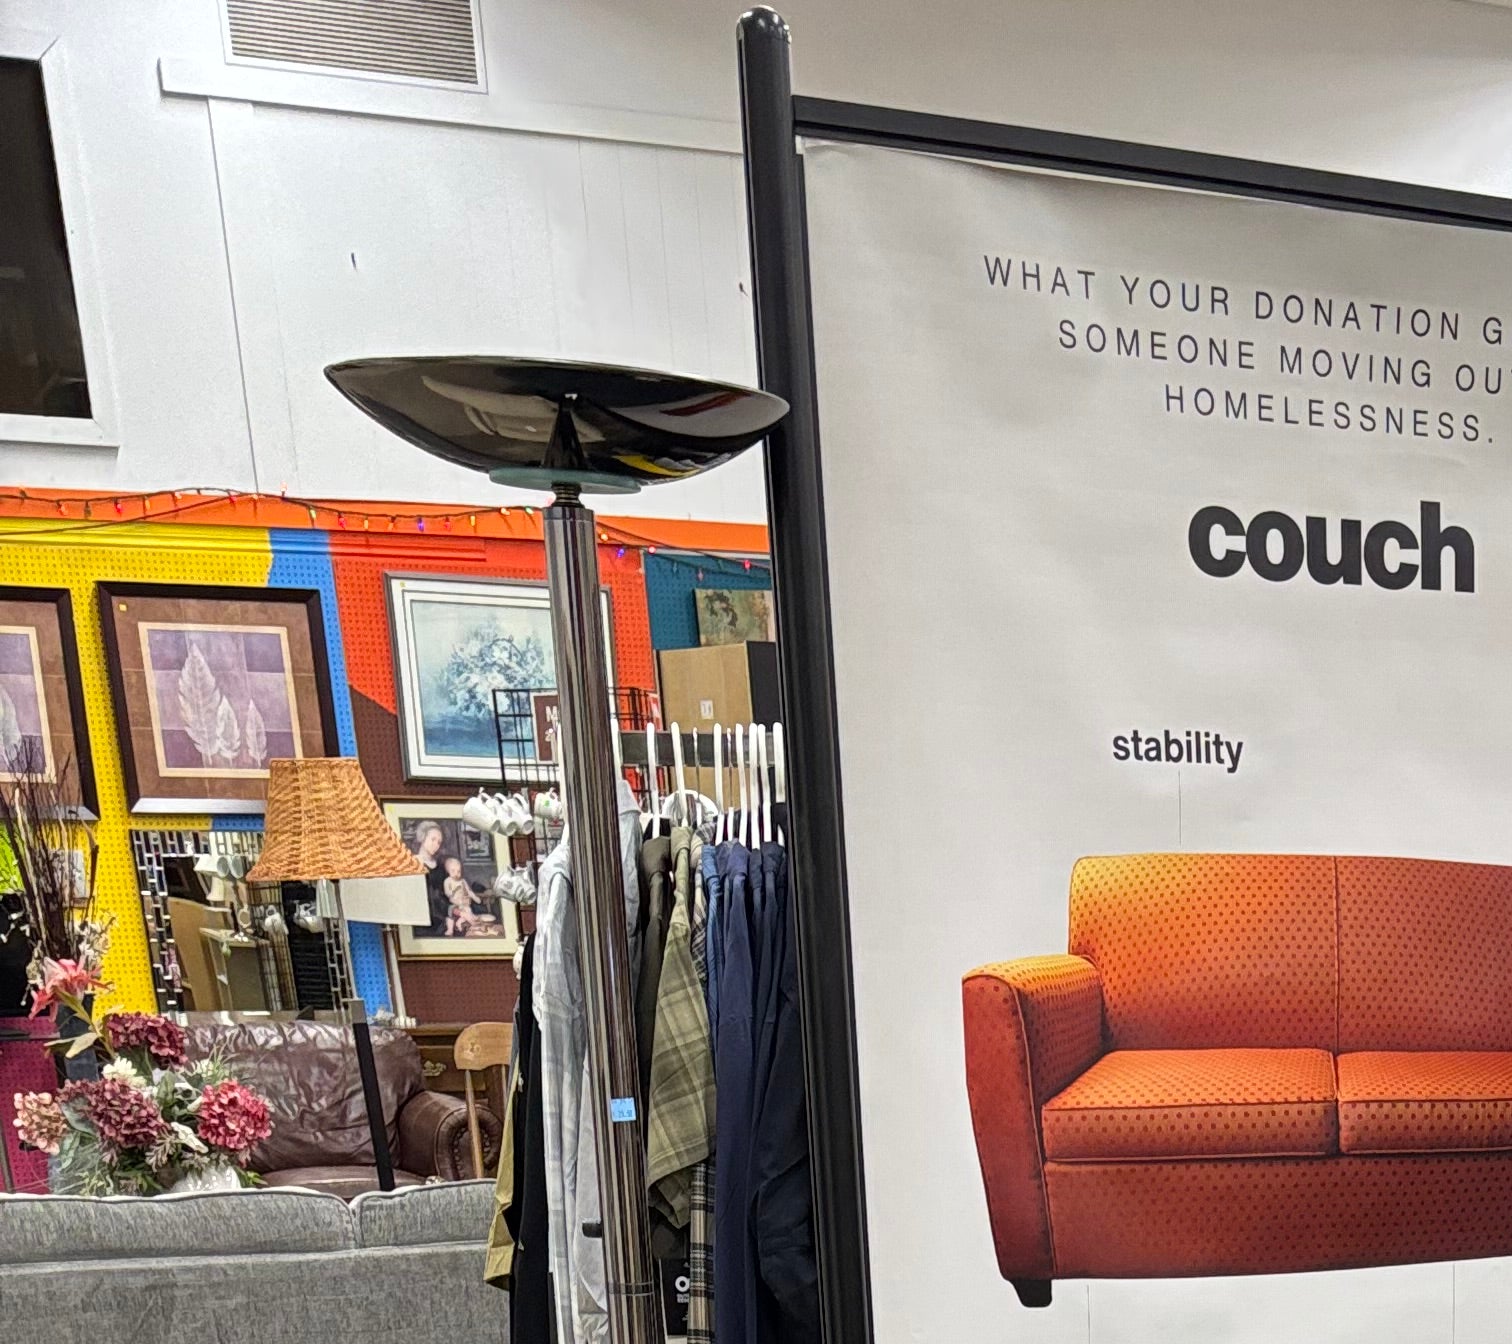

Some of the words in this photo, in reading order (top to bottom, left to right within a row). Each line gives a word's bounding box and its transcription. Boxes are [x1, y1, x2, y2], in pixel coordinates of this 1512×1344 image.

[983, 255, 1096, 301] WHAT
[1120, 275, 1230, 316] YOUR
[1254, 291, 1460, 340] DONATION
[1058, 320, 1256, 370] SOMEONE
[1280, 345, 1433, 388] MOVING
[1165, 384, 1494, 444] HOMELESSNESS.
[1187, 500, 1476, 594] couch
[1111, 729, 1244, 773] stability
